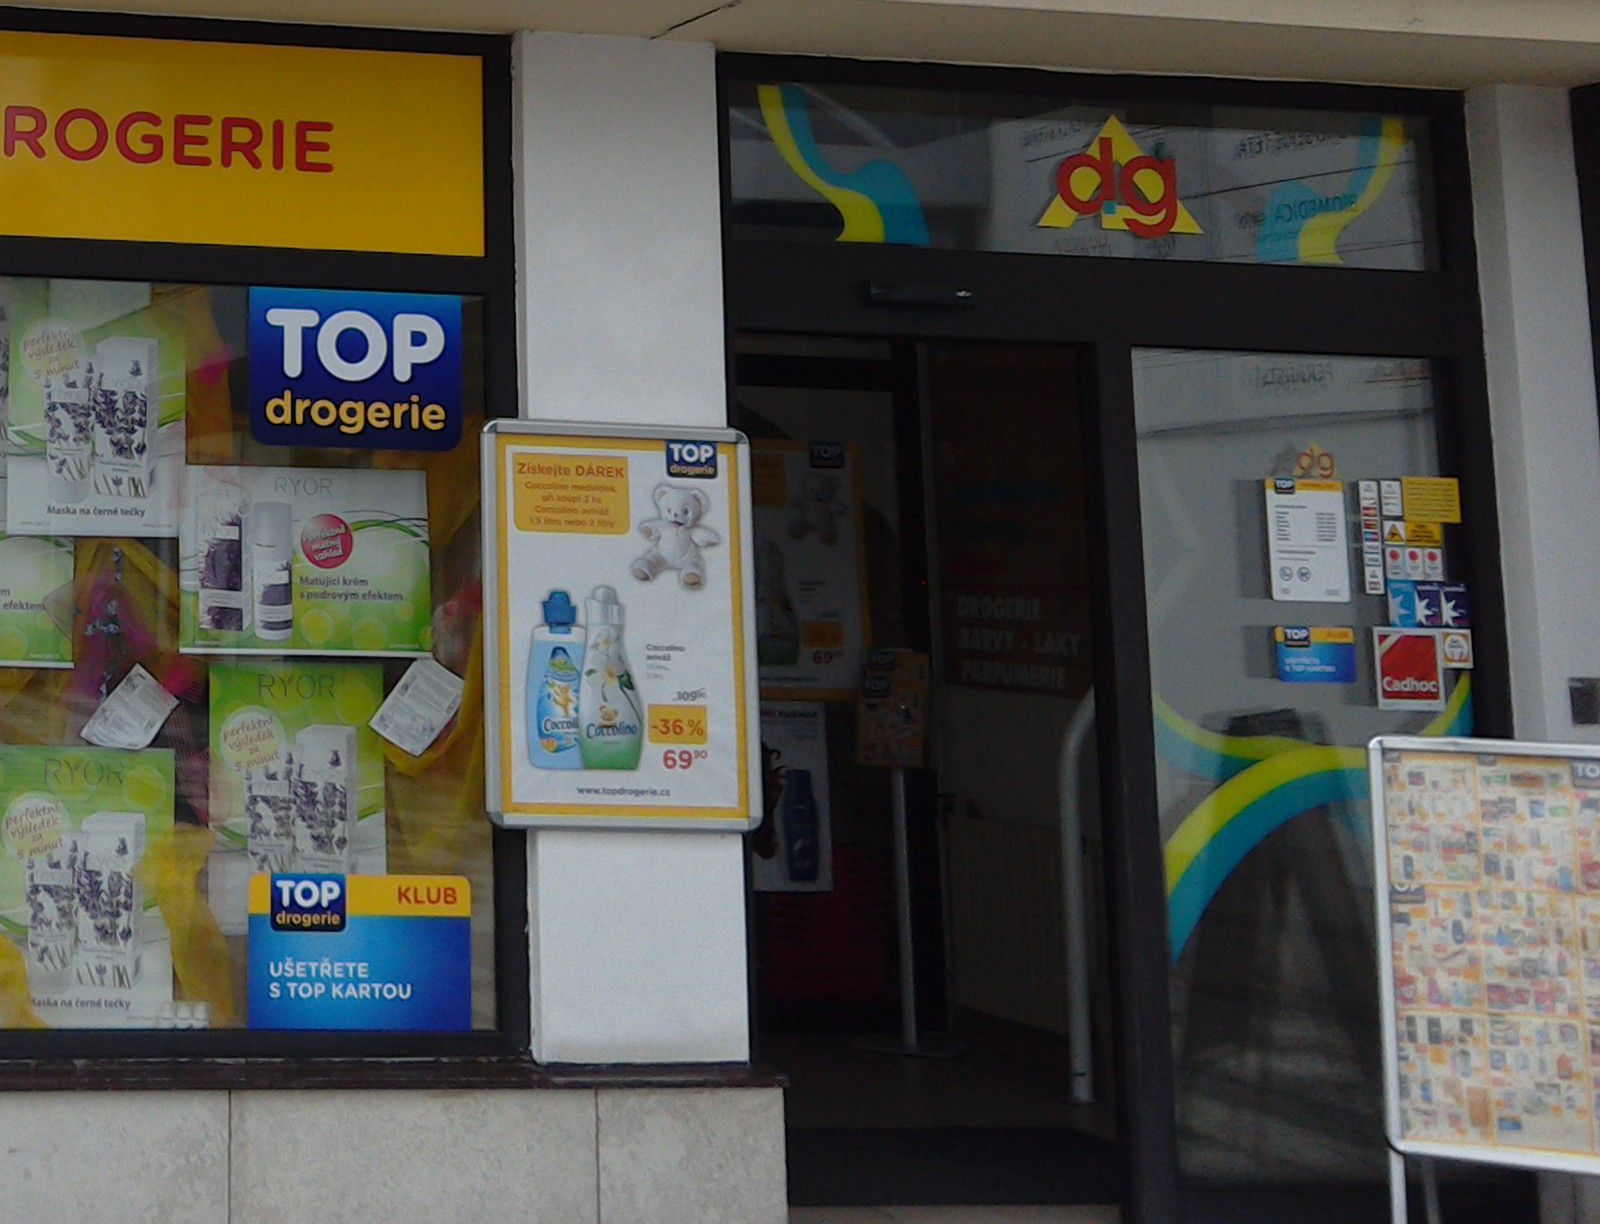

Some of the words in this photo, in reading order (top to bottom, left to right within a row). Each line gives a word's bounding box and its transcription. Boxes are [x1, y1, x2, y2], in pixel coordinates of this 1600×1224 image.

[266, 307, 446, 384] TOP
[265, 388, 446, 435] drogerie
[669, 443, 714, 463] TOP
[517, 462, 571, 478] Získejte
[576, 460, 625, 478] DÁREK
[275, 477, 332, 496] RYOR
[47, 504, 77, 516] Maska
[79, 508, 91, 516] na
[342, 575, 369, 587] krém
[258, 673, 336, 699] RYOR
[1383, 675, 1439, 693] Cadhoc
[652, 719, 684, 736] -36
[687, 719, 704, 736] %
[45, 758, 125, 786] RYOR
[275, 879, 342, 908] TOP
[396, 885, 459, 906] KLUB
[275, 910, 341, 927] drogerie
[269, 957, 370, 979] UŠETŘETE
[269, 982, 282, 1000] S
[285, 982, 327, 999] TOP
[331, 982, 412, 1000] KARTOU
